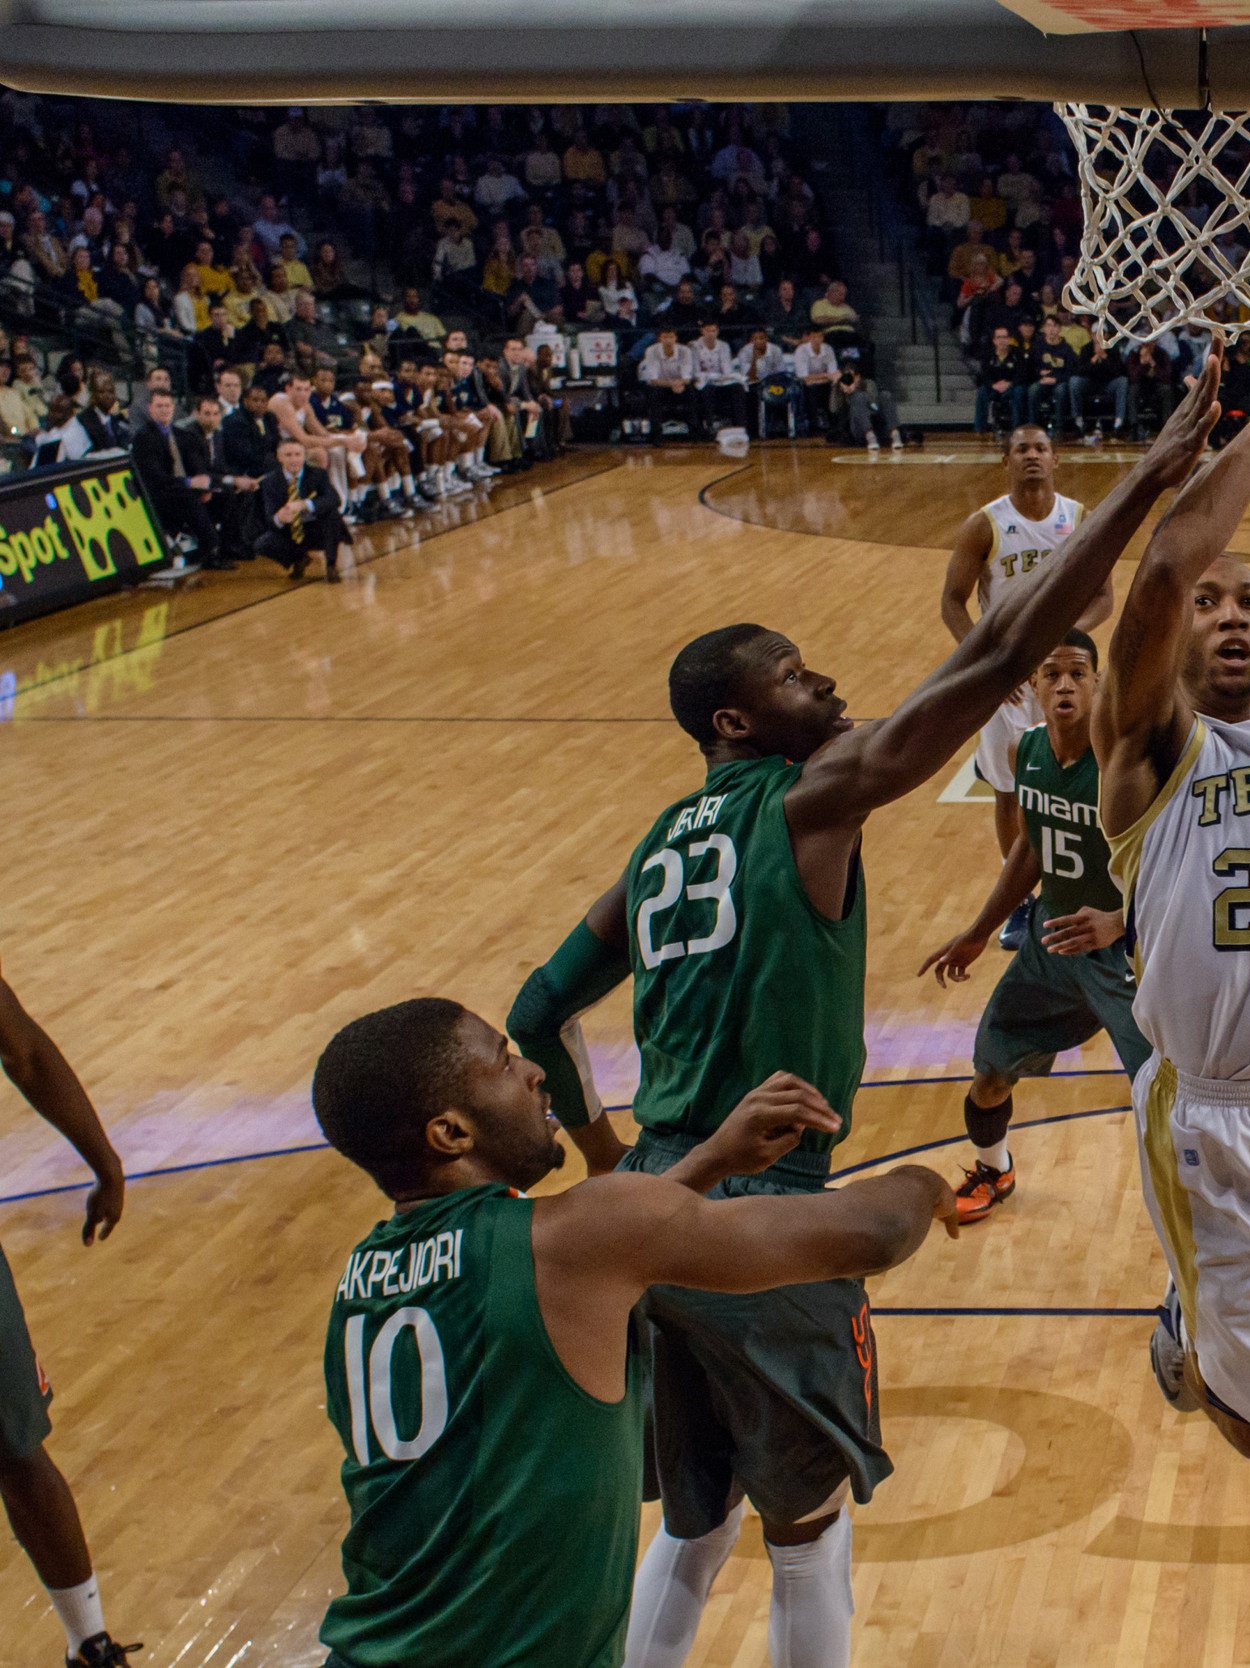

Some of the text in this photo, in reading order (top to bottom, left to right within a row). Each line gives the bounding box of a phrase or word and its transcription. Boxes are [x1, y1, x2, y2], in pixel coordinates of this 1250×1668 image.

[637, 833, 737, 971] 23
[1041, 826, 1085, 880] 15
[336, 1229, 464, 1302] AKPEJIORI
[344, 1306, 449, 1467] 10
